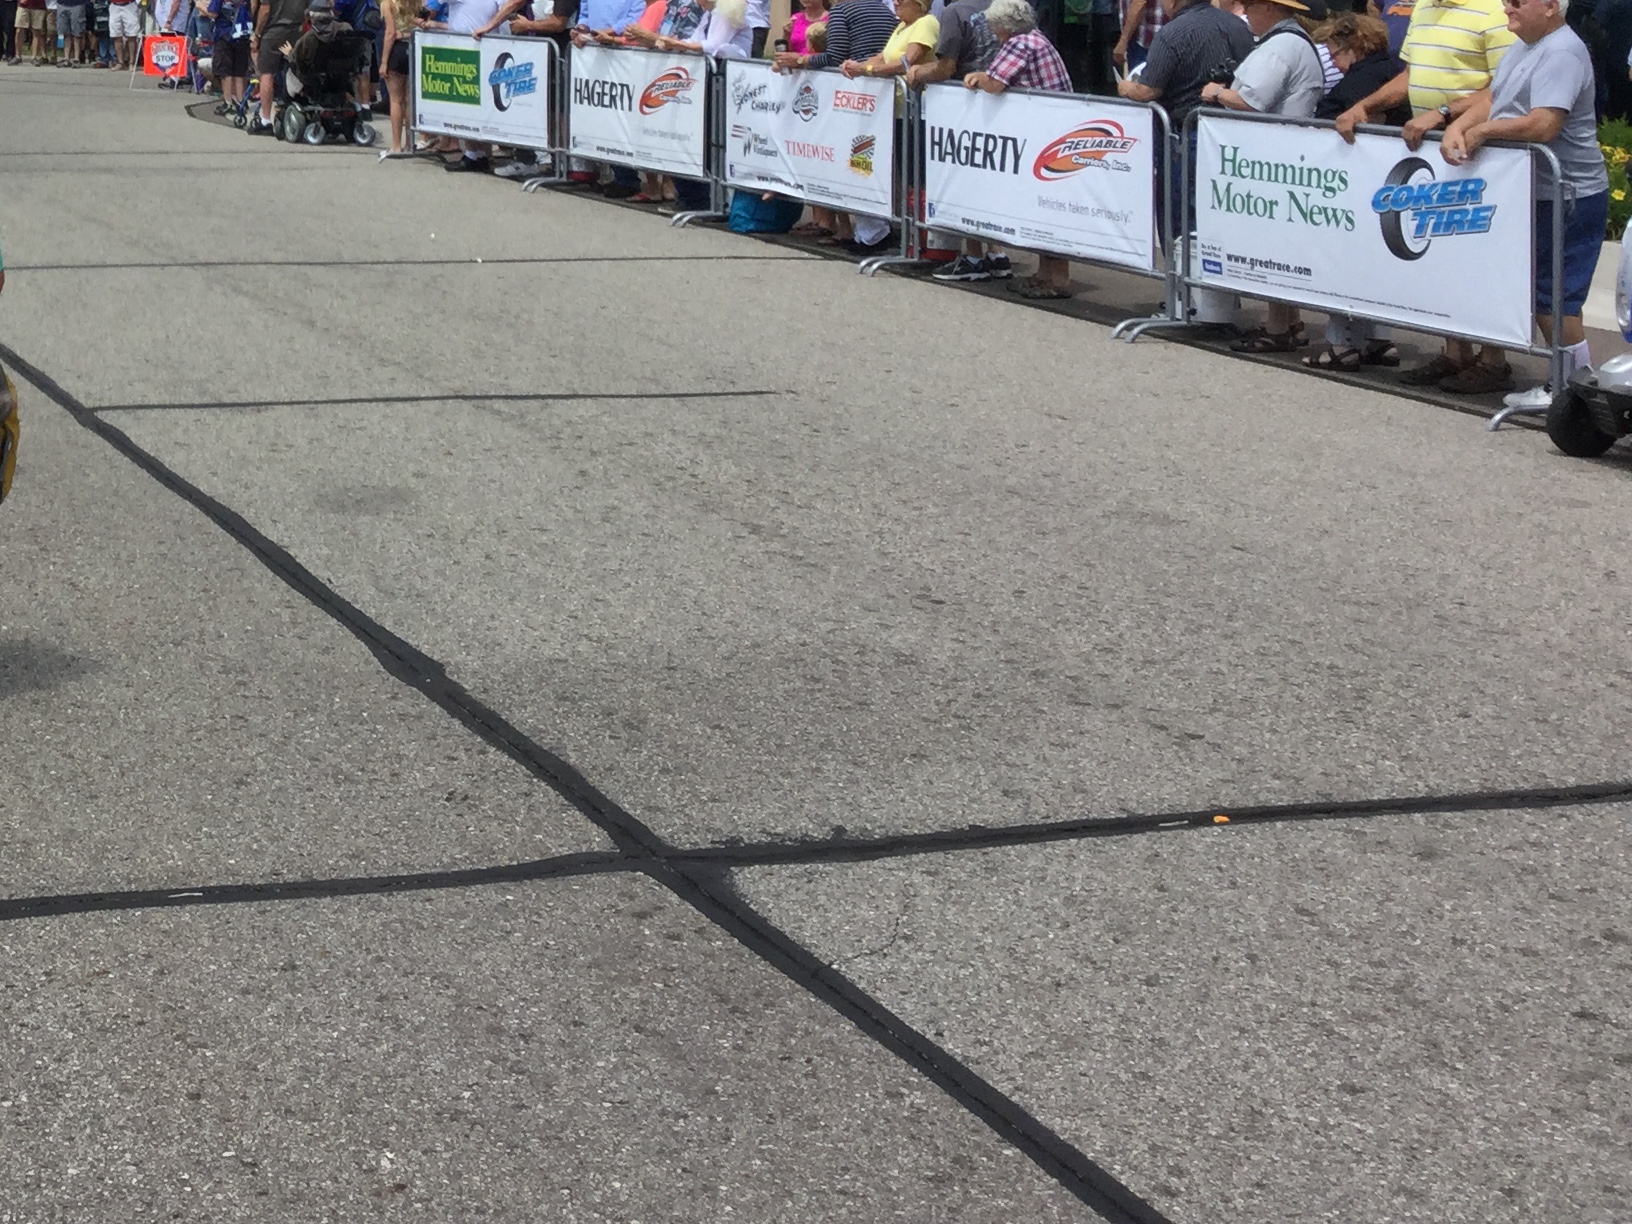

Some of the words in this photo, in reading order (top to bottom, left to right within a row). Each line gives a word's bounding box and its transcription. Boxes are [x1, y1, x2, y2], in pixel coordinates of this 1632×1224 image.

[425, 54, 477, 81] Hemmings
[422, 74, 451, 95] Motor
[452, 76, 480, 98] News
[573, 77, 636, 113] HAGERTY
[833, 90, 876, 112] ECKLER'S
[784, 139, 836, 163] TIMEWISE
[930, 126, 1028, 175] HAGERTY
[1060, 138, 1132, 154] RELIABLE
[1218, 144, 1349, 199] Hemmings
[1068, 201, 1090, 216] taken
[1210, 179, 1279, 220] Motor
[1286, 190, 1356, 232] News
[1371, 177, 1487, 213] COKER
[1410, 203, 1498, 239] TIRE
[1226, 252, 1312, 277] www.greatrace.com
